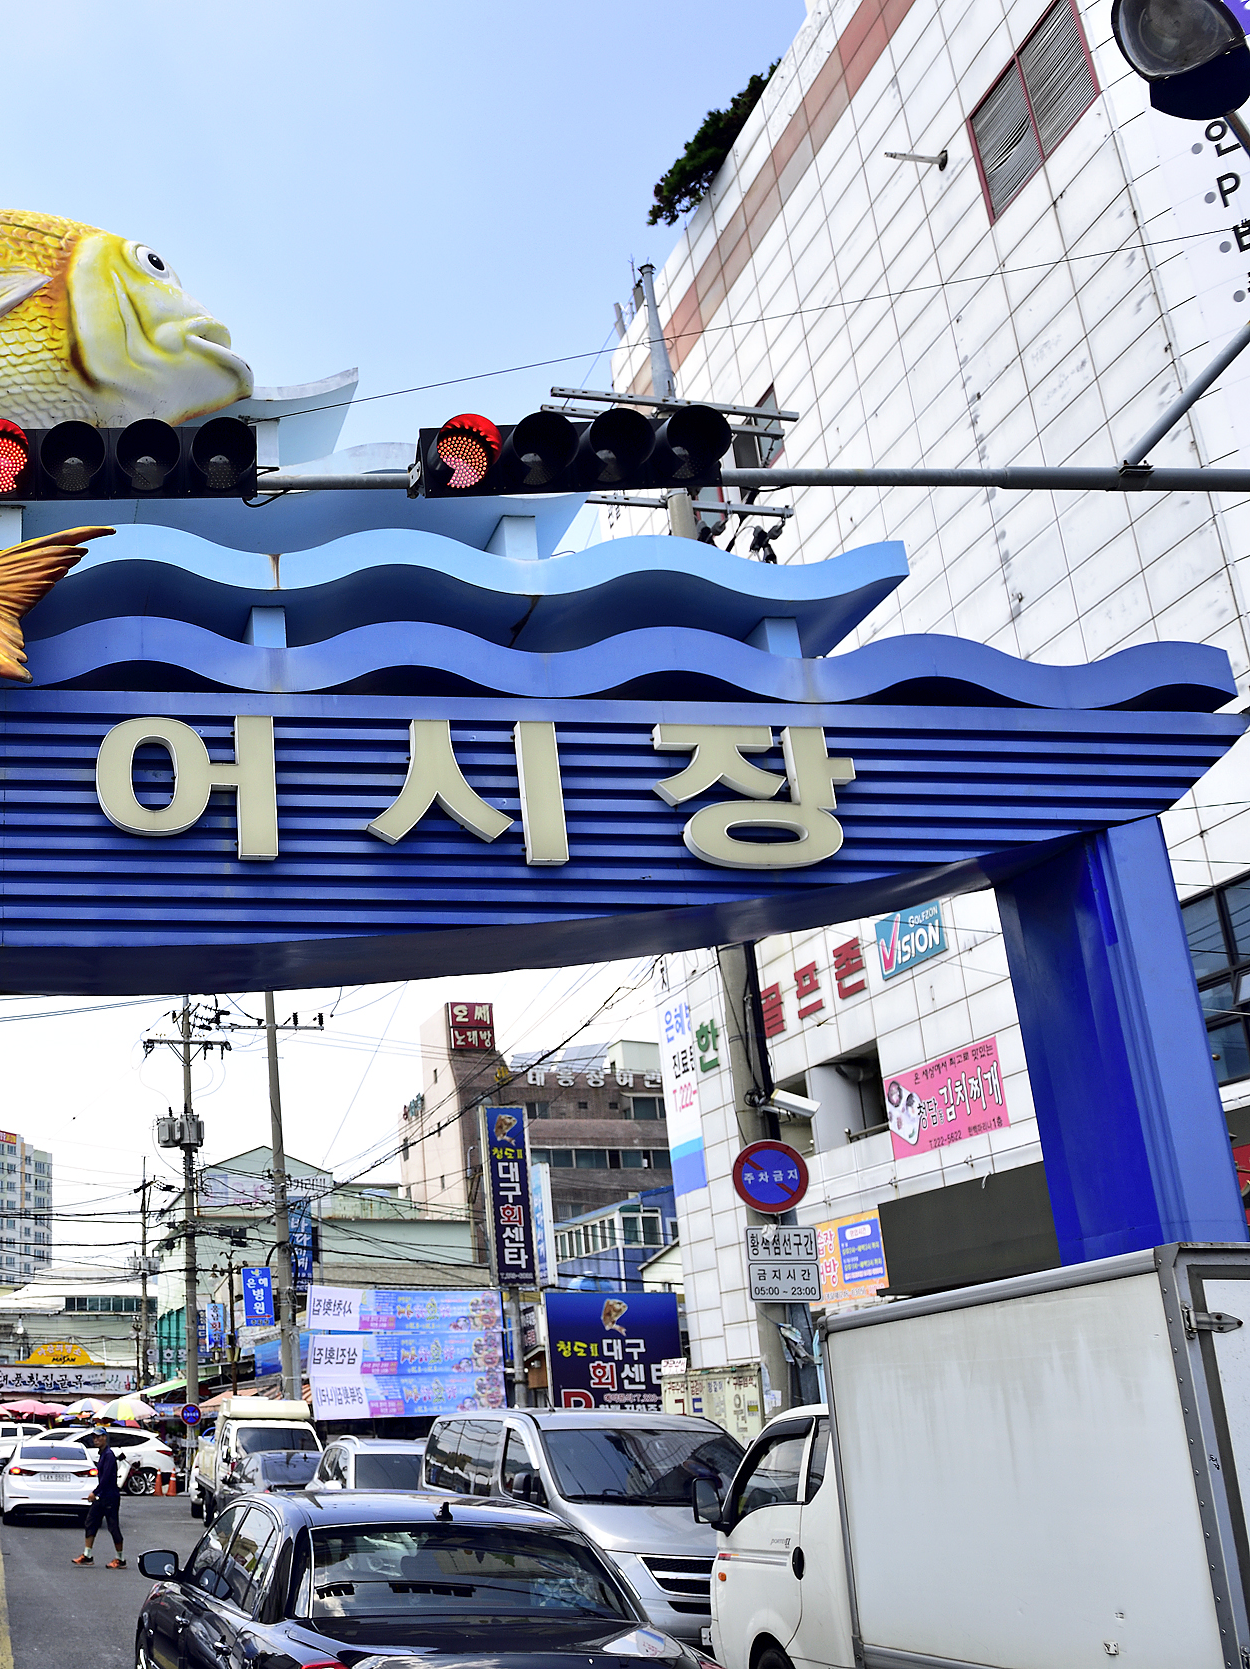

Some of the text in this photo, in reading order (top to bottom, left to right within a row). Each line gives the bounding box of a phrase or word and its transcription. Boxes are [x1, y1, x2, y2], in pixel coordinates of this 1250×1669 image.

[760, 935, 867, 1038] 골프존
[454, 1030, 493, 1047] 노래방
[938, 1059, 1004, 1123] 김치찌개
[743, 1168, 800, 1185] 주차금지
[497, 1161, 529, 1269] 대구회센타
[756, 1268, 812, 1282] 금지시간
[754, 1286, 781, 1297] 05:00
[790, 1286, 817, 1297] 23:00
[602, 1338, 646, 1361] 대구
